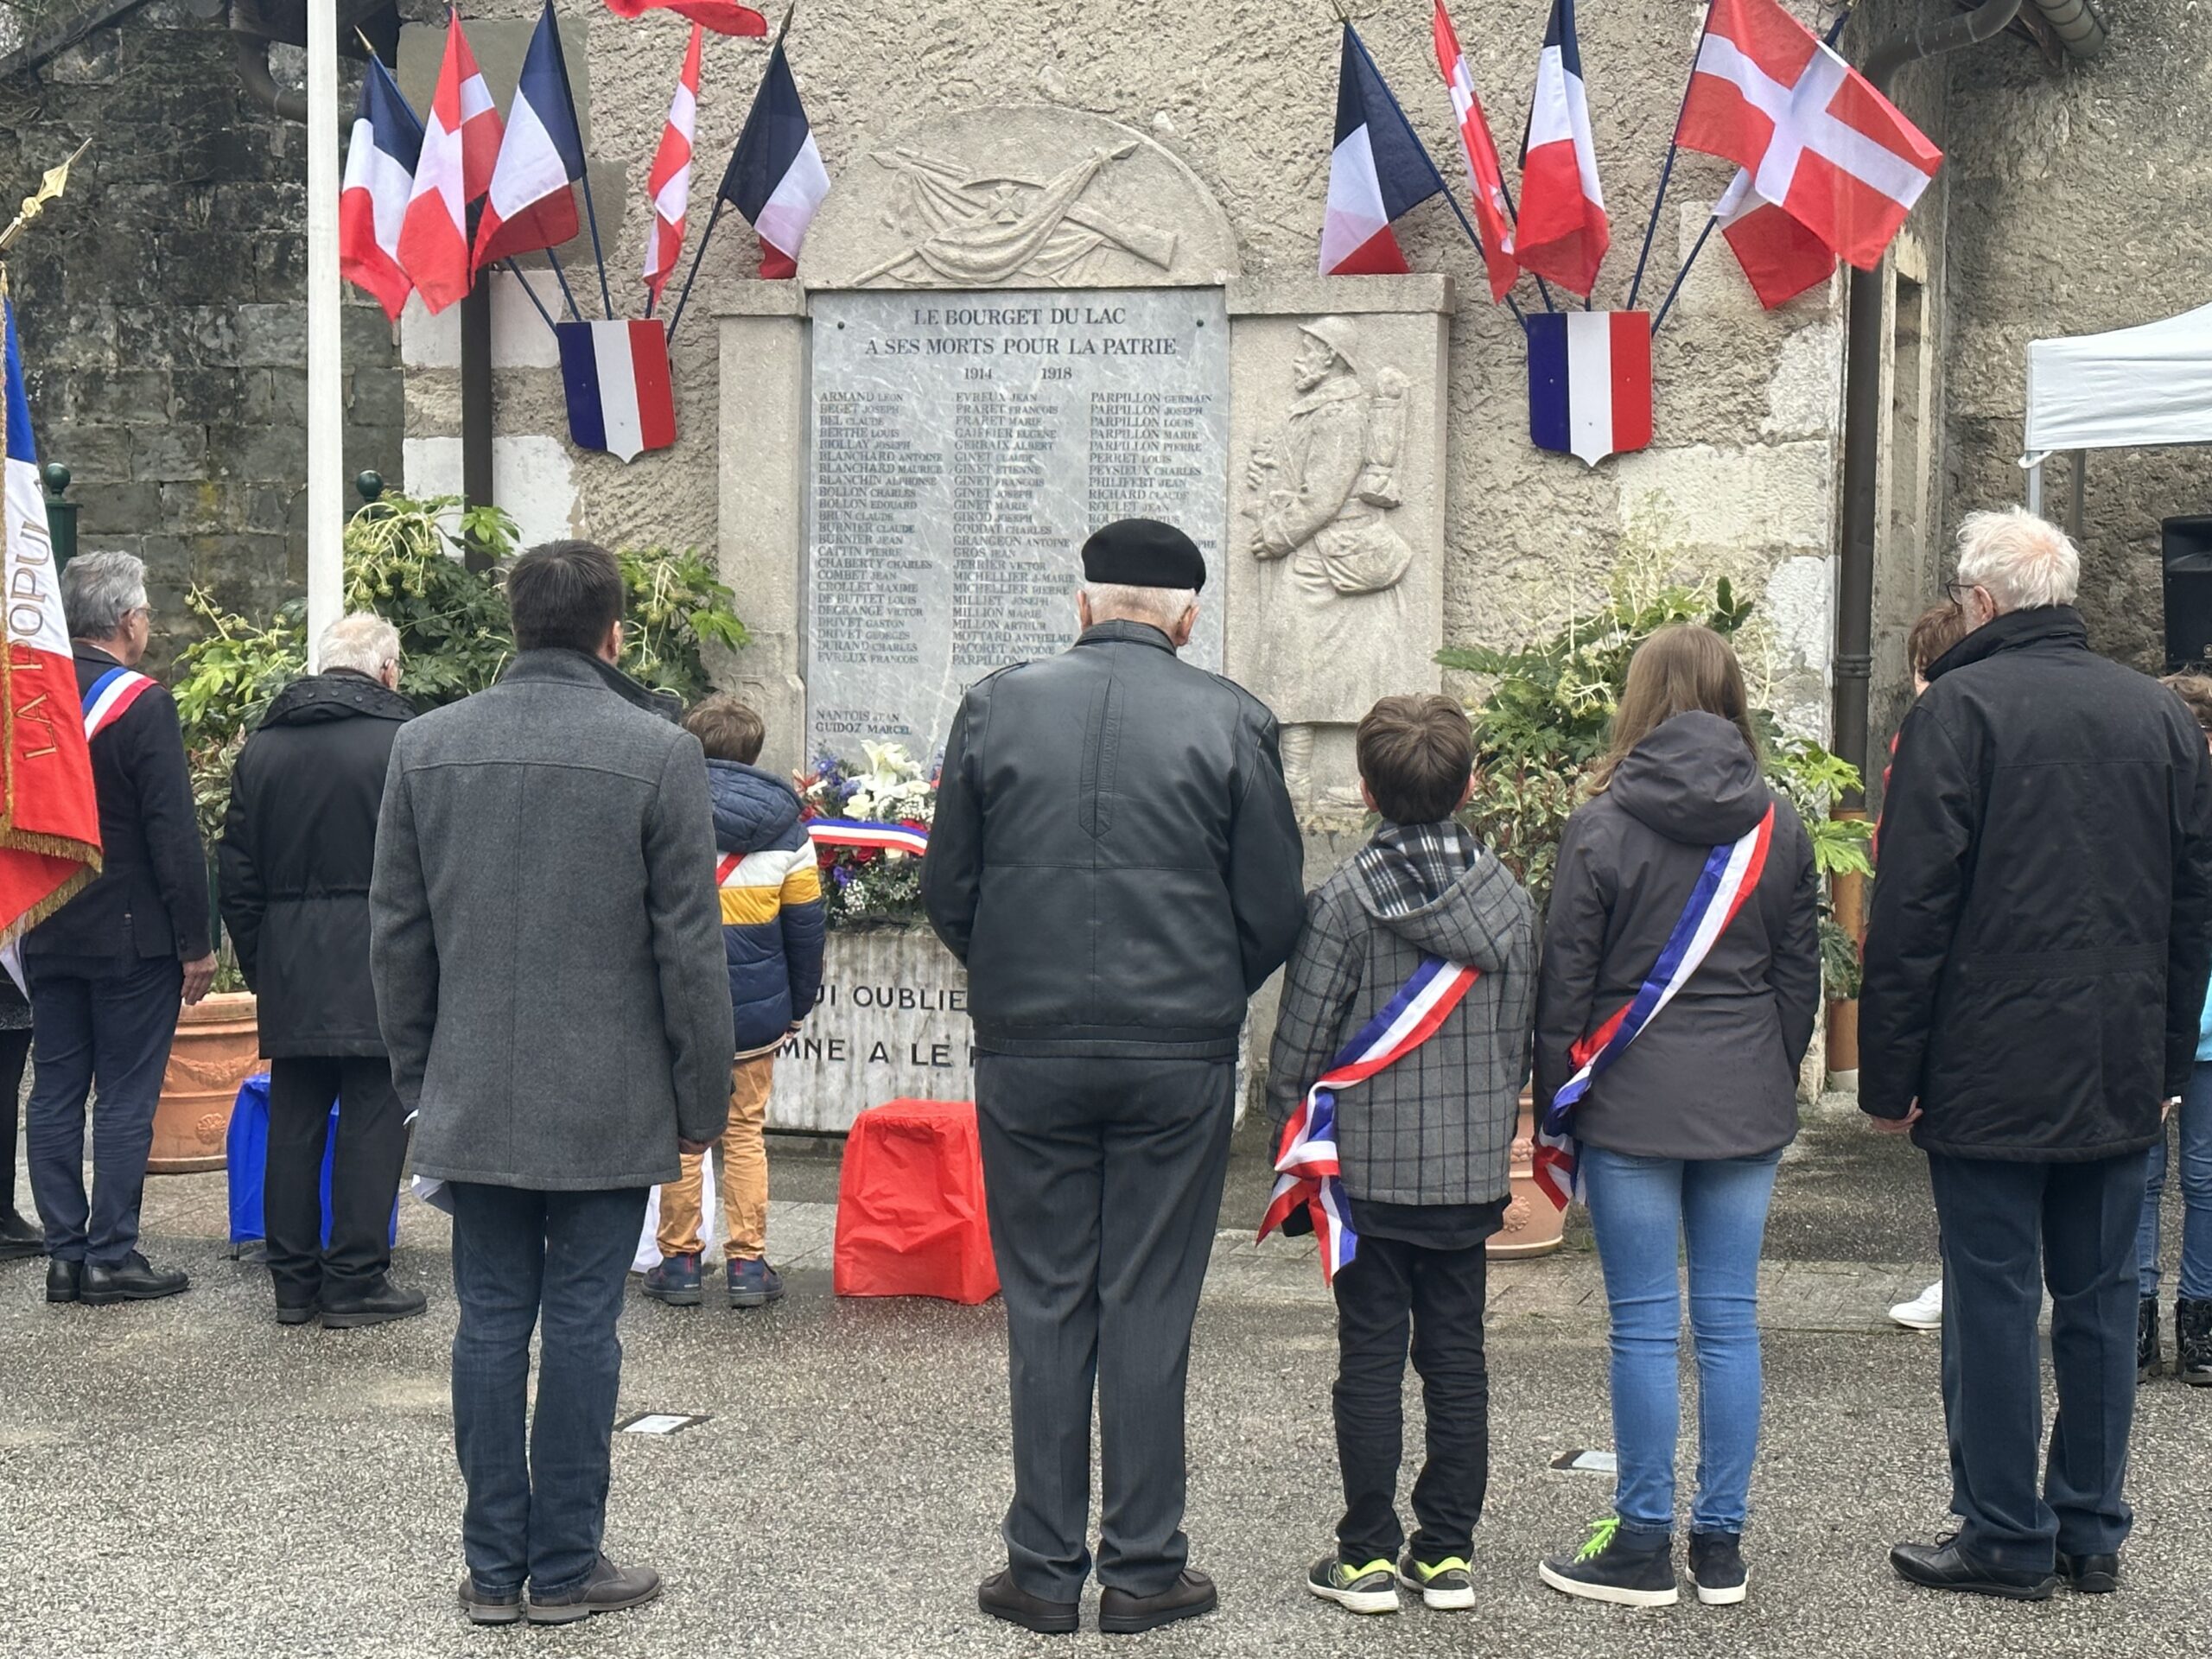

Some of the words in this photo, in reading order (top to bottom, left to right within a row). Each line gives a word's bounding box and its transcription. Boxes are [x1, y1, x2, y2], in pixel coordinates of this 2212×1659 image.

[914, 308, 939, 325] LE
[945, 308, 1042, 326] BOURGET
[1051, 308, 1078, 325] DU
[1084, 308, 1126, 325] LAC
[865, 339, 878, 355] A
[884, 338, 920, 355] SES
[925, 338, 995, 355] MORTS
[1003, 338, 1059, 355] POUR
[1068, 338, 1096, 354] LA
[1103, 338, 1176, 355] PATRIE
[963, 368, 992, 380] 1914
[1041, 366, 1072, 380] 1918
[820, 391, 874, 402] ARMAND
[878, 393, 903, 402] LEON
[956, 391, 1006, 402] EVREUX
[1010, 393, 1037, 402] JEAN
[1090, 392, 1160, 403] PARPILLON
[1164, 394, 1212, 404] GERMAIN
[820, 404, 860, 414] BEGET
[862, 405, 899, 414] JOSEPH
[1090, 404, 1160, 415] PARPILLON
[1164, 406, 1203, 415] JOSEPH
[820, 416, 842, 426] BEL
[846, 417, 884, 426] CLAUDE
[1008, 417, 1042, 426] MARIE
[1090, 416, 1160, 427] PARPILLON
[1163, 418, 1194, 428] LOUIS
[820, 427, 868, 438] BERTHE
[871, 429, 899, 438] LOUIS
[1090, 429, 1160, 439] PARPILLON
[1164, 430, 1198, 440] MARIE
[874, 441, 911, 450] JOSEPH
[1014, 442, 1053, 450] ALBERT
[1090, 441, 1160, 451] PARPILLON
[1164, 442, 1203, 452] PIERRE
[819, 451, 895, 461] BLANCHARD
[899, 453, 943, 461] ANTOINE
[954, 452, 993, 462] GINET
[995, 454, 1035, 462] CLAUDE
[1090, 453, 1139, 463] PERRET
[1141, 455, 1172, 464] LOUIS
[819, 463, 895, 474] BLANCHARD
[954, 464, 992, 474] GINET
[995, 466, 1041, 474] ETIENNE
[1154, 467, 1201, 476] CHARLES
[819, 474, 881, 485] BLANCHIN
[886, 477, 938, 486] ALPHONSE
[954, 476, 992, 486] GINET
[1160, 479, 1186, 487] JEAN
[819, 486, 867, 497] BOLLON
[870, 488, 916, 498] CHARLES
[954, 487, 992, 498] GINET
[995, 490, 1033, 499] JOSEPH
[1089, 489, 1146, 499] RICHARD
[1149, 491, 1189, 500] CLAUDE
[819, 499, 867, 509] BOLLON
[870, 501, 918, 510] EDOUARD
[954, 499, 992, 510] GINET
[995, 502, 1029, 511] MARIE
[1089, 501, 1139, 512] ROULET
[1141, 503, 1169, 512] JEAN
[818, 511, 852, 521] BRUN
[855, 512, 893, 521] CLAUDE
[818, 522, 873, 533] BURNIER
[876, 524, 915, 534] CLAUDE
[1005, 525, 1052, 534] CHARLES
[818, 534, 873, 544] BURNIER
[876, 536, 903, 544] JEAN
[953, 536, 1021, 546] GRANGEON
[1027, 538, 1071, 547] ANTOINE
[866, 548, 901, 556] PIERRE
[953, 547, 986, 558] GROS
[991, 550, 1015, 558] JEAN
[887, 560, 932, 569] CHARLES
[1009, 562, 1046, 570] VICTOR
[817, 569, 868, 580] COMBET
[870, 572, 897, 581] JEAN
[876, 583, 918, 593] MAXIME
[1033, 586, 1070, 595] PIERRE
[887, 595, 917, 605] LOUIS
[1011, 597, 1049, 606] JOSEPH
[817, 606, 884, 616] DEGRANGE
[887, 607, 923, 616] VICTOR
[1008, 609, 1042, 619] MARIE
[866, 620, 905, 628] GASTON
[1004, 621, 1046, 631] ARTHUR
[866, 632, 911, 640] GEORGES
[952, 632, 1012, 642] MOTTARD
[817, 640, 869, 651] DURAND
[871, 643, 918, 652] CHARLES
[952, 643, 1005, 653] PACORET
[1010, 645, 1055, 654] ANTOINE
[817, 652, 867, 663] EVREUX
[816, 710, 870, 722] NANTOIS
[14, 693, 57, 760] LA
[816, 722, 863, 734] GUIDOZ
[868, 725, 912, 735] MARCEL
[853, 986, 968, 1012] OUBLIE
[868, 1041, 890, 1064] A
[912, 1043, 952, 1068] LE
